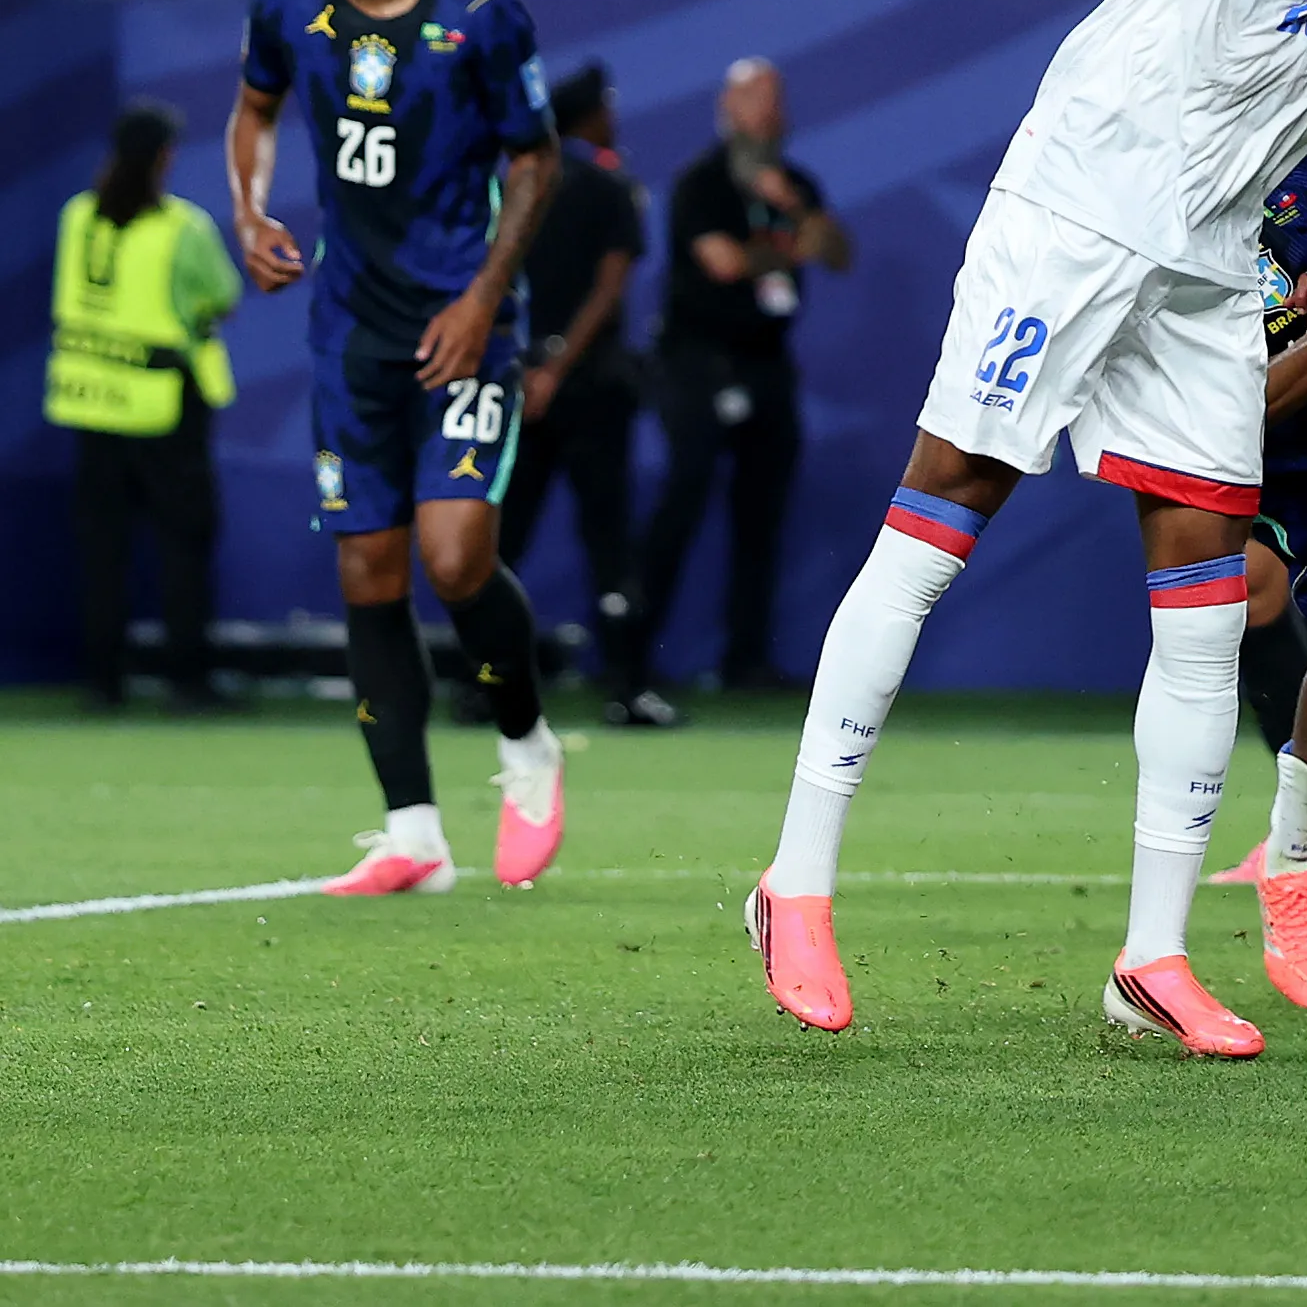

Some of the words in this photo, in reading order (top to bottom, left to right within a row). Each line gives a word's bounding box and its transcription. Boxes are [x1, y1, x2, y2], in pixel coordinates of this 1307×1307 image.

[336, 116, 397, 188] 26
[1257, 274, 1269, 289] BF
[975, 306, 1048, 394] 22
[442, 377, 506, 444] 26
[840, 717, 877, 740] FHF
[1190, 780, 1224, 796] FHF
